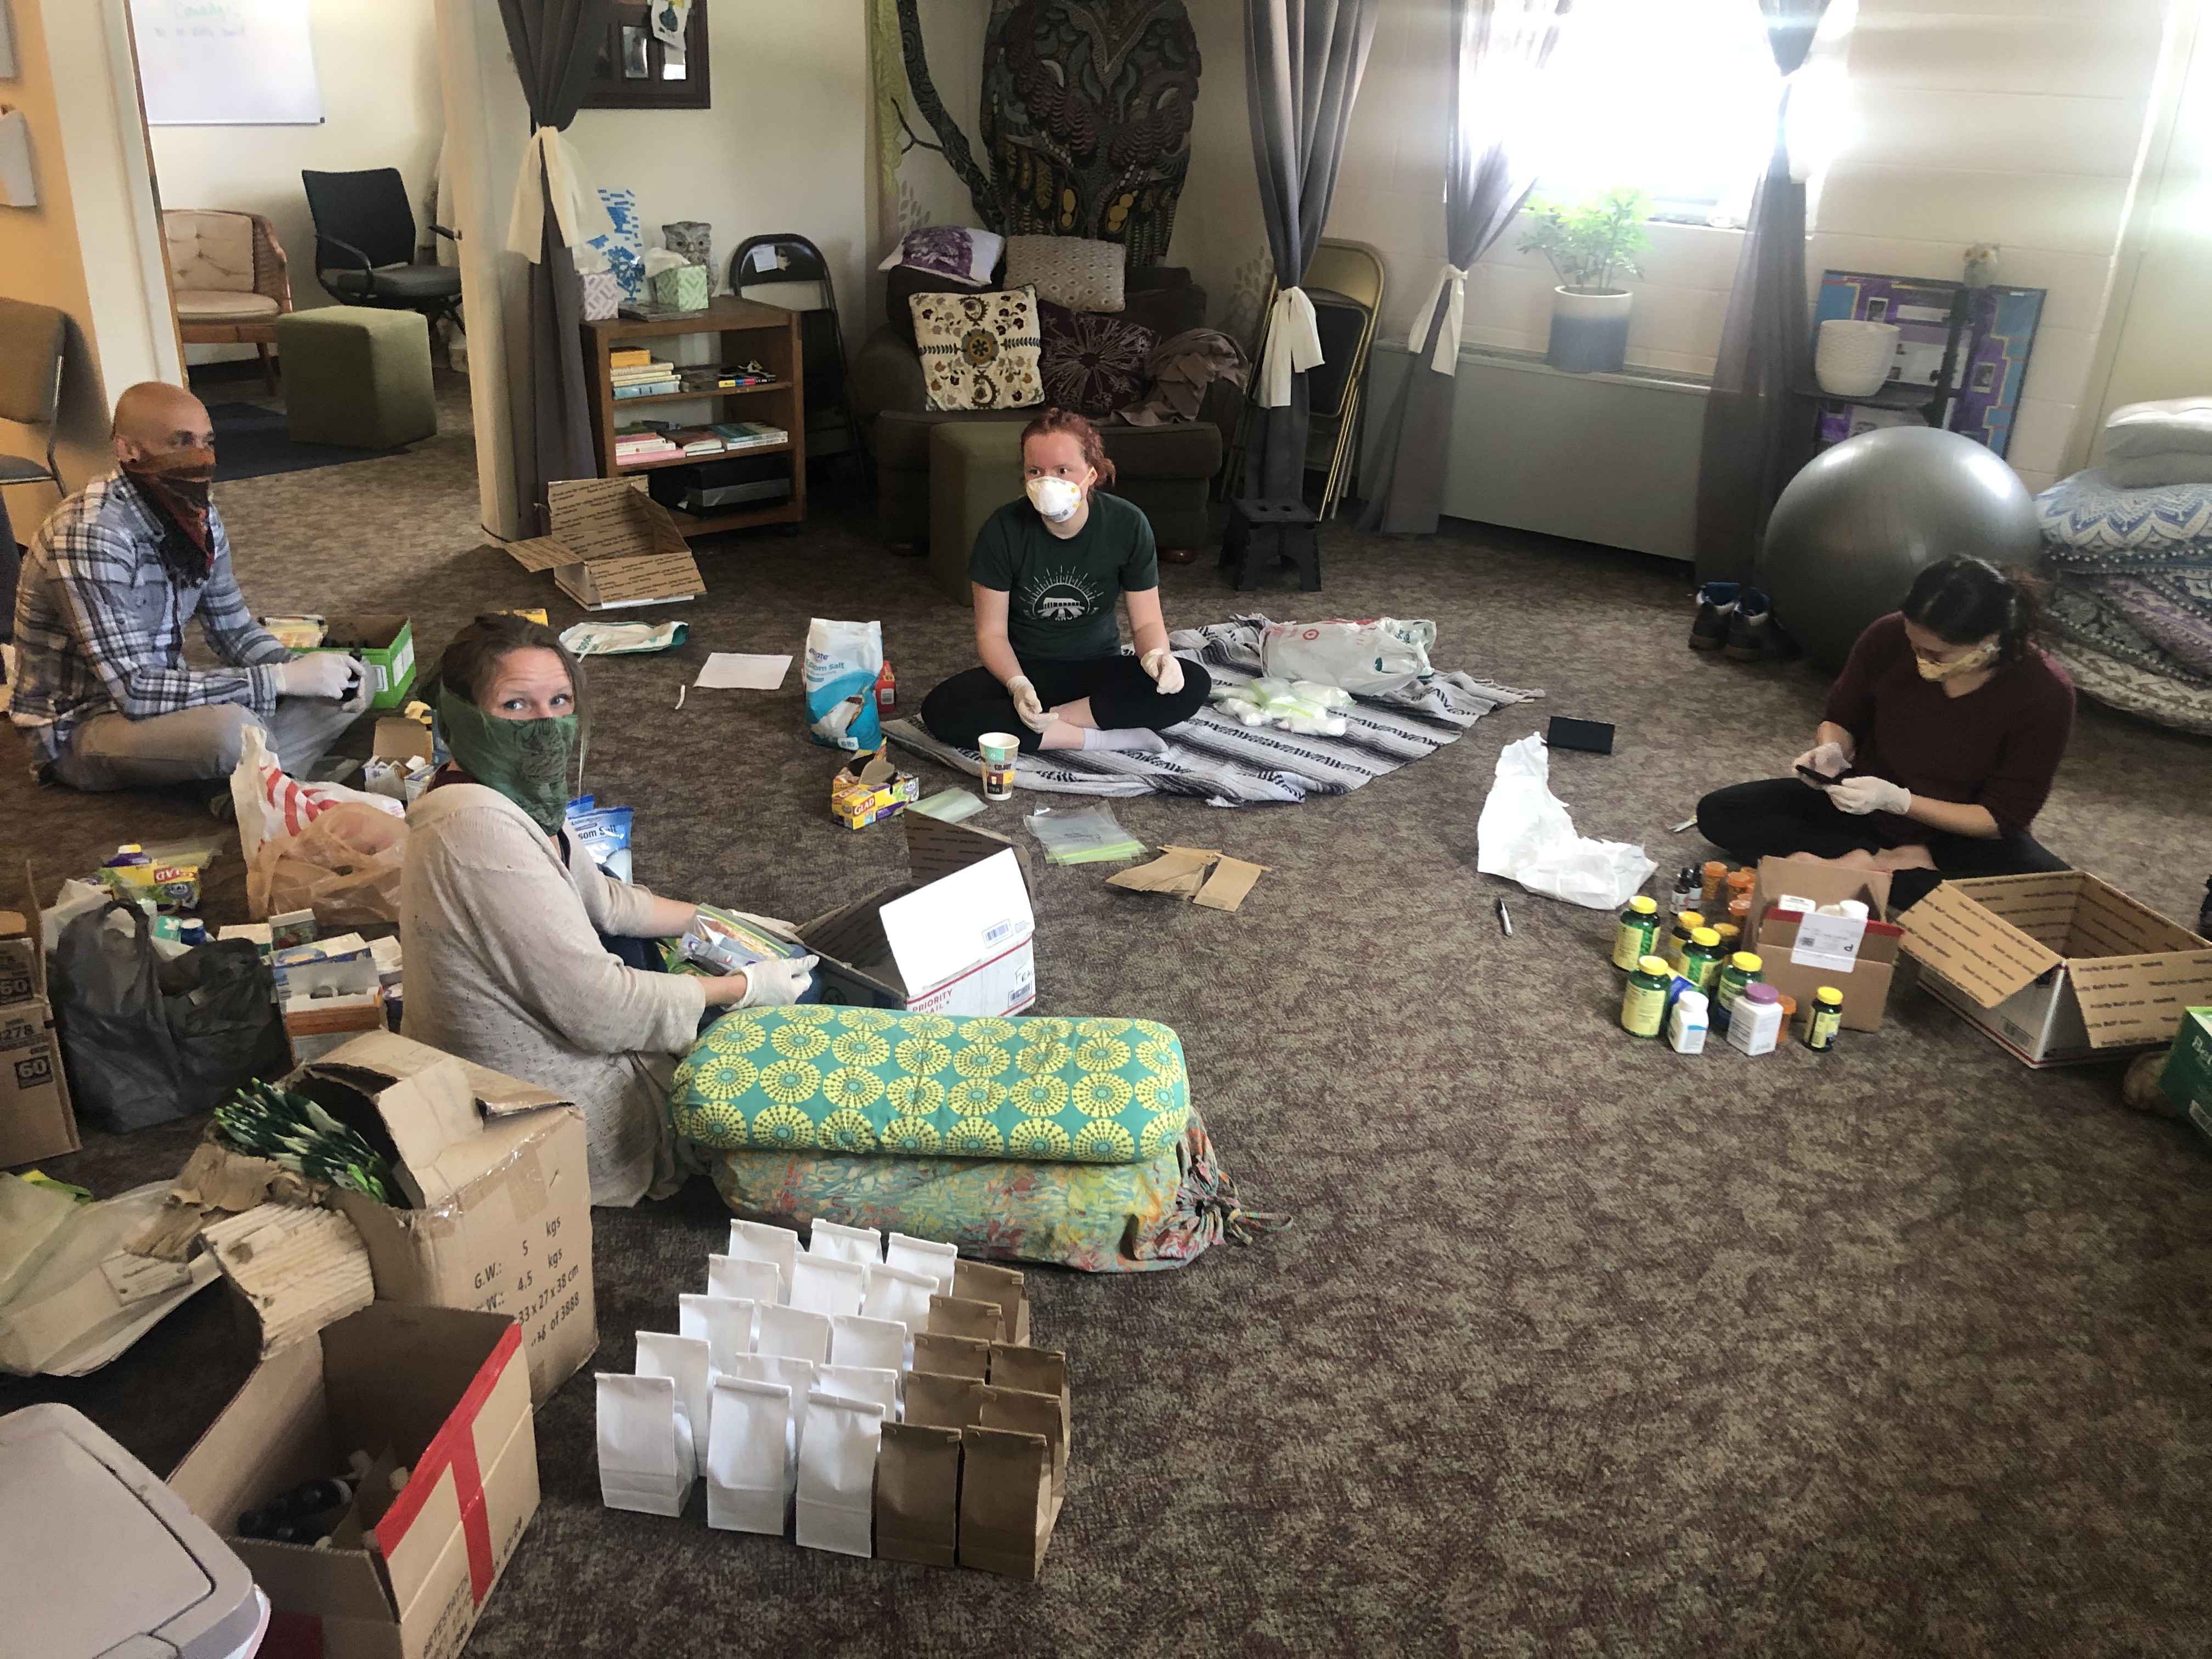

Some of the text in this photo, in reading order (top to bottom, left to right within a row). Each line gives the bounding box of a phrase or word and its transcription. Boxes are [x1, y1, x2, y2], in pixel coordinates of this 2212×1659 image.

[806, 658, 845, 672] Epom Salt
[854, 798, 874, 815] GLAD
[578, 830, 597, 840] som
[912, 989, 952, 1012] PRIORITY
[926, 1004, 944, 1013] AIL
[0, 1024, 34, 1042] 278
[19, 1059, 48, 1078] 60
[474, 1216, 561, 1289] G.W.: 5 kgs
[517, 1270, 533, 1291] 4.5
[548, 1248, 563, 1269] kgs
[518, 1264, 579, 1326] 33 x 27 x 38 cm
[550, 1310, 560, 1331] of
[561, 1291, 580, 1321] 3888
